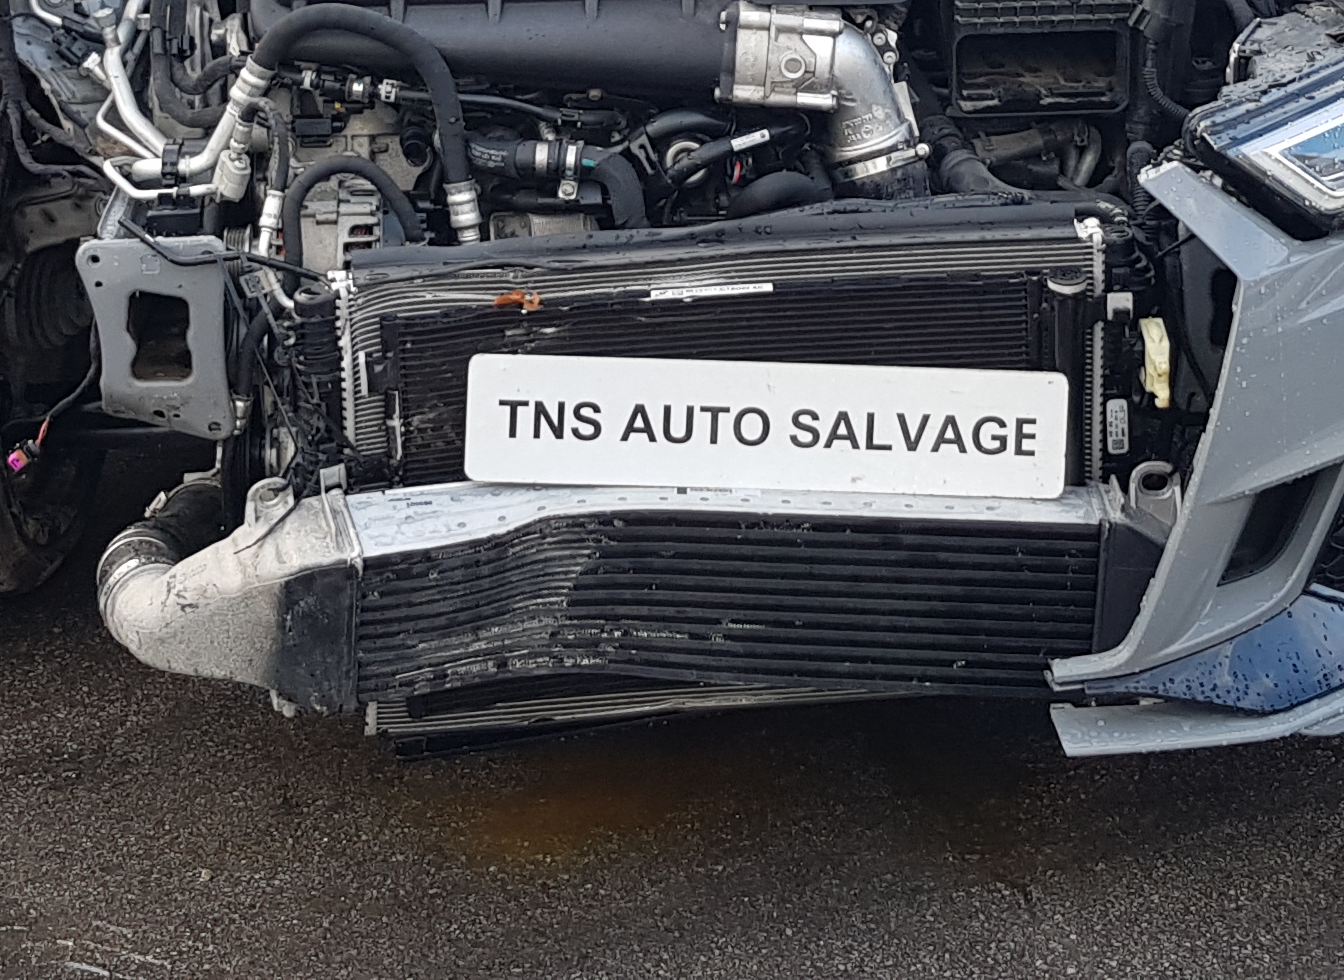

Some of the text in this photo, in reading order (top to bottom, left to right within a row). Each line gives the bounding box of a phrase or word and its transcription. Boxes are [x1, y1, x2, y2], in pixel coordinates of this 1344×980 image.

[498, 399, 1038, 457] TNS AUTO SALVAGE
